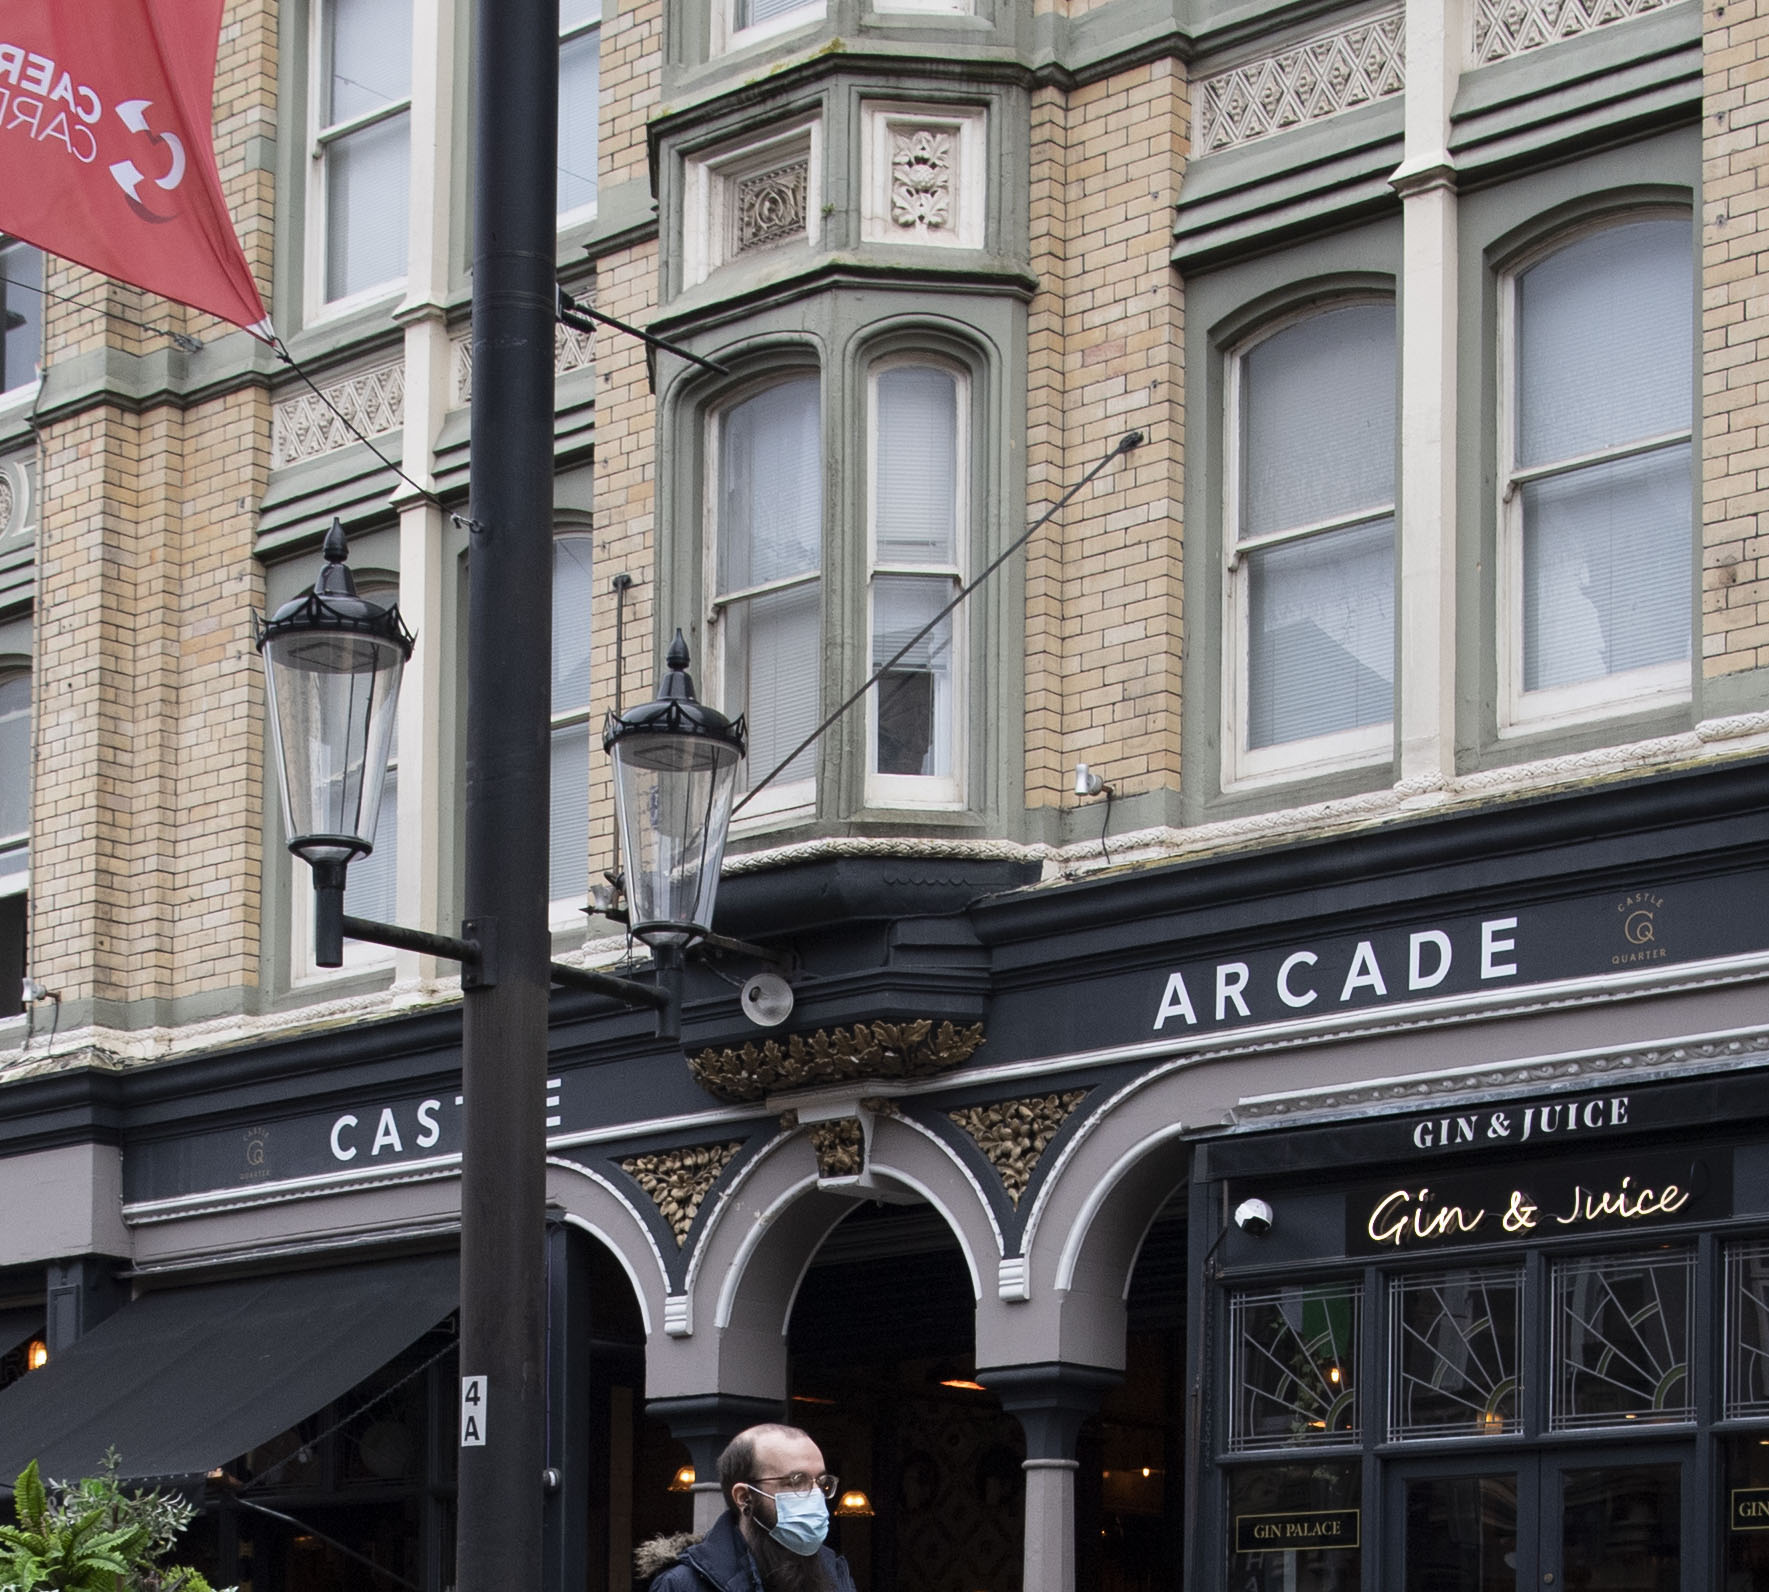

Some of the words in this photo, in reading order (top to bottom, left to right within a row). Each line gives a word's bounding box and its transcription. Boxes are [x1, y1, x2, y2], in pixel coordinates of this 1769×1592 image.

[1617, 893, 1664, 912] CASTLE
[1612, 948, 1667, 965] QUARTER
[1152, 916, 1518, 1030] ARCADE
[330, 1078, 562, 1161] CASE
[1413, 1115, 1478, 1148] GIN
[1487, 1111, 1511, 1138] &
[1520, 1096, 1630, 1142] JUICE
[1367, 1188, 1485, 1245] Gin
[1502, 1190, 1538, 1232] &
[1556, 1176, 1690, 1224] Juice
[464, 1380, 481, 1407] 4
[463, 1415, 481, 1443] A
[1254, 1524, 1282, 1539] GIN
[1286, 1521, 1342, 1537] PALACE
